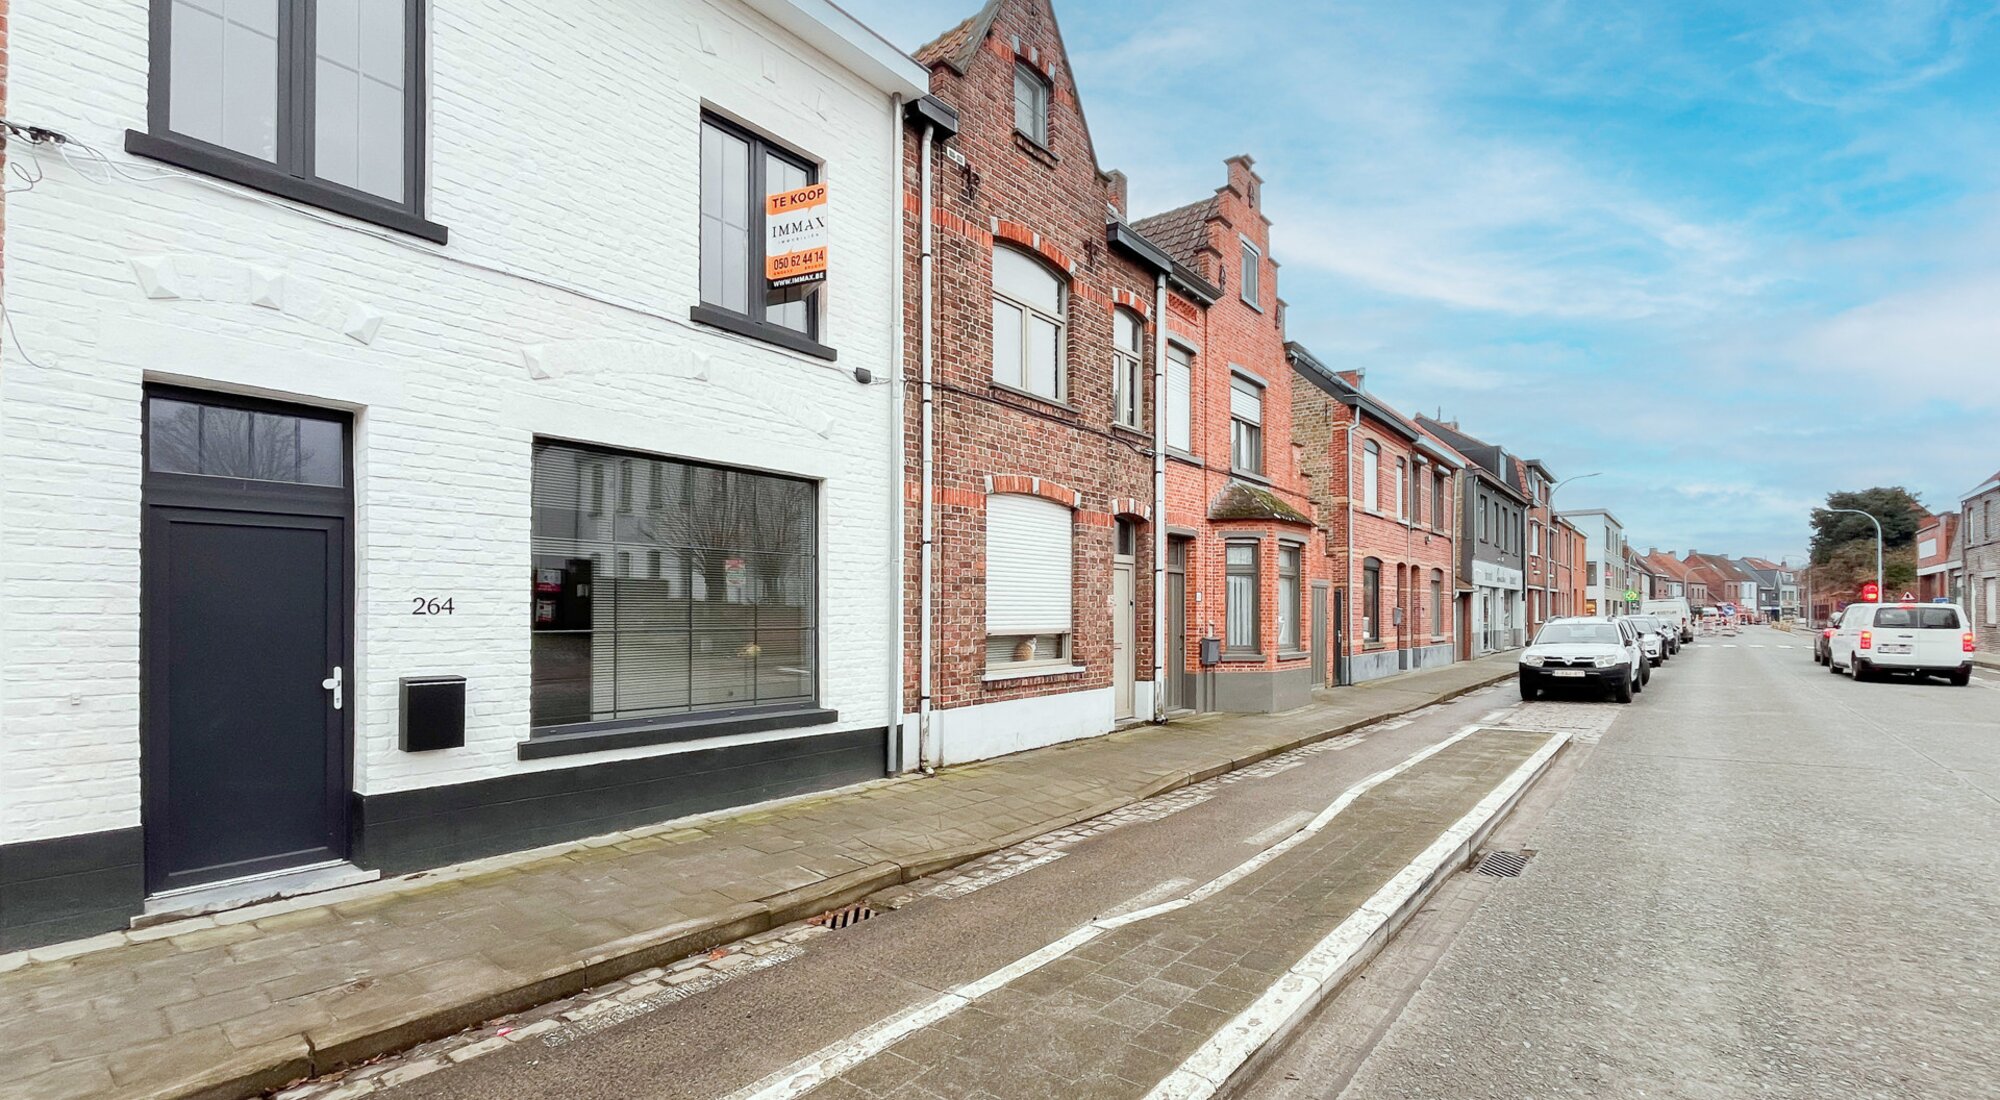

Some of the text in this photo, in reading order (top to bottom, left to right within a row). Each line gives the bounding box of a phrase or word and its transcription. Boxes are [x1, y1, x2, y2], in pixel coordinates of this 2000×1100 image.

[772, 188, 825, 208] TE KOOP
[772, 217, 825, 237] IMMAX
[774, 257, 788, 270] 050
[791, 254, 800, 267] 62
[803, 253, 812, 263] 44
[814, 250, 823, 262] 14
[773, 272, 824, 287] WWW.IMMAX.BE
[412, 597, 455, 615] 264
